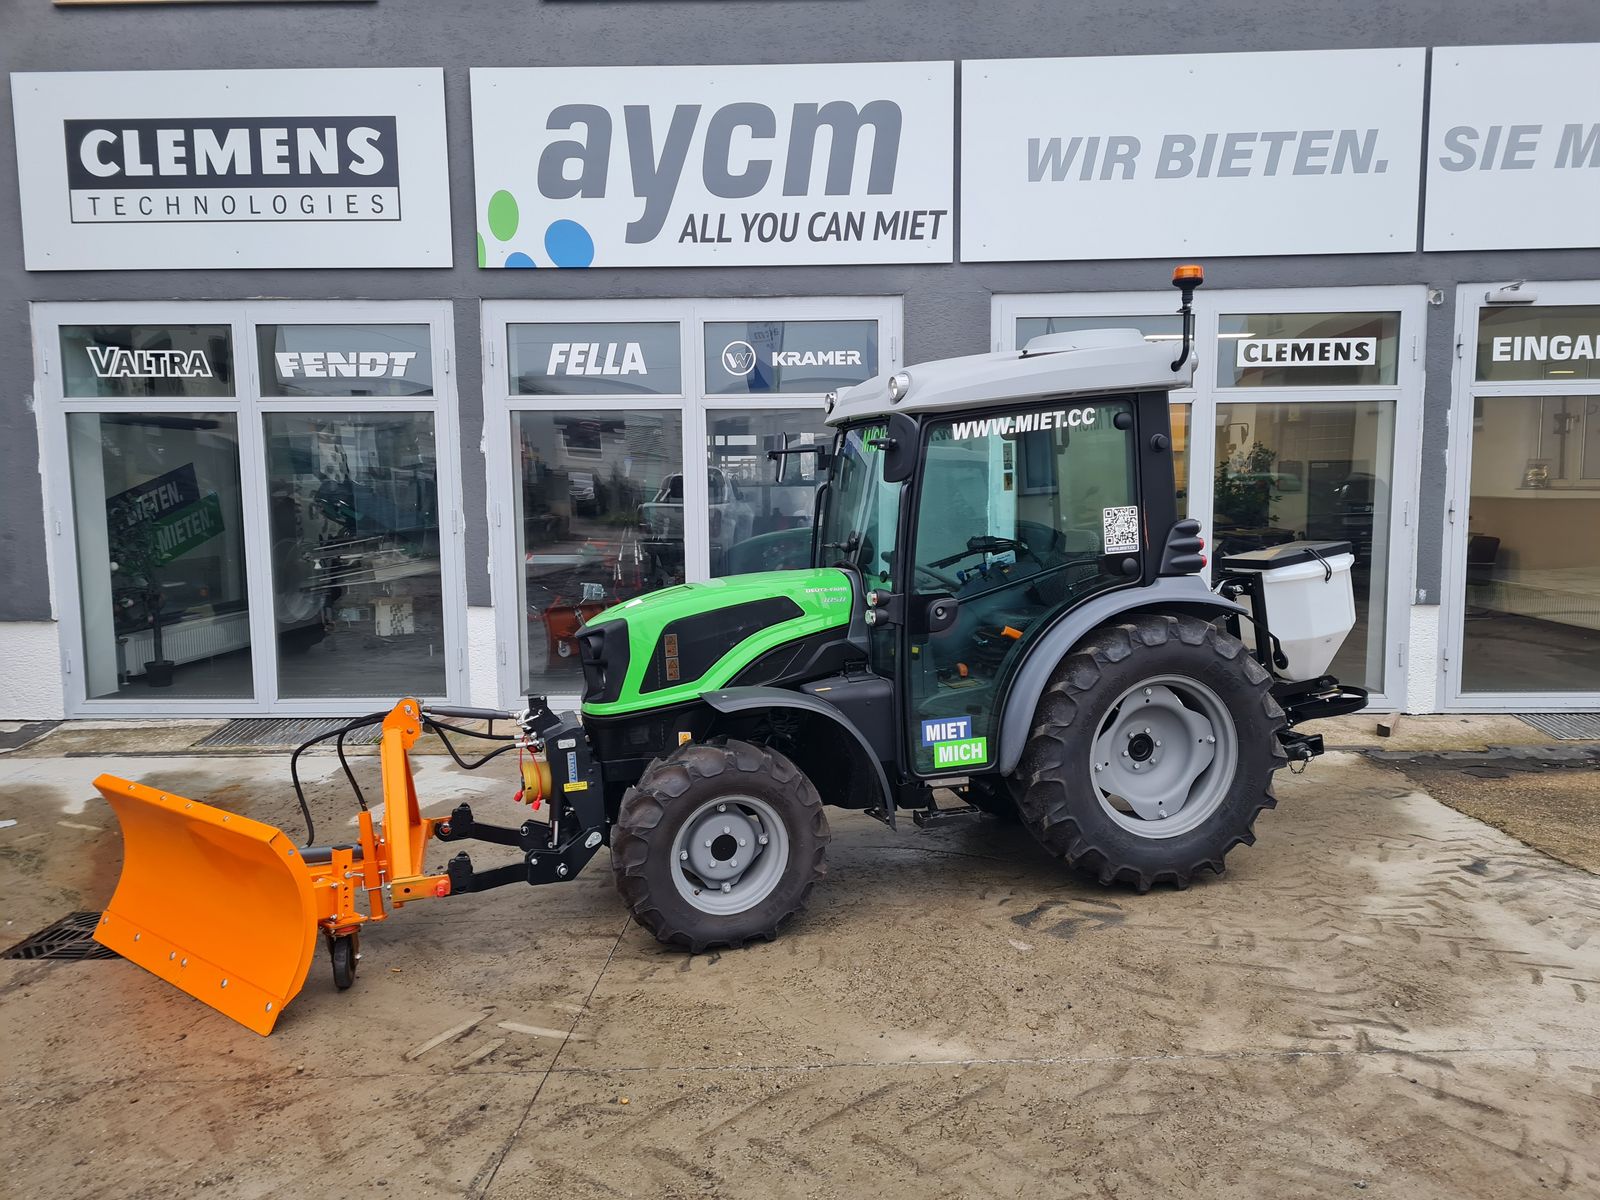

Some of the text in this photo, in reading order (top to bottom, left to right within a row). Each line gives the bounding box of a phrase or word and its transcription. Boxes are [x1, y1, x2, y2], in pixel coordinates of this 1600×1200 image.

[79, 126, 385, 178] CLEMENS
[1027, 128, 1390, 183] WIR BIETEN.
[1438, 125, 1544, 172] SIE
[536, 99, 903, 244] aycm
[87, 193, 386, 217] TECHNOLOGIES
[678, 209, 948, 244] ALL YOU CAN MIET
[86, 346, 214, 378] VALTRA
[546, 342, 648, 376] FELLA
[771, 350, 862, 367] KRAMER
[1242, 340, 1372, 363] CLEMENS
[1492, 334, 1600, 362] EINGA
[274, 351, 418, 378] FENDT
[952, 407, 1096, 441] WWW.MIET.CC
[925, 720, 969, 742] MIET
[938, 742, 984, 765] MICH
